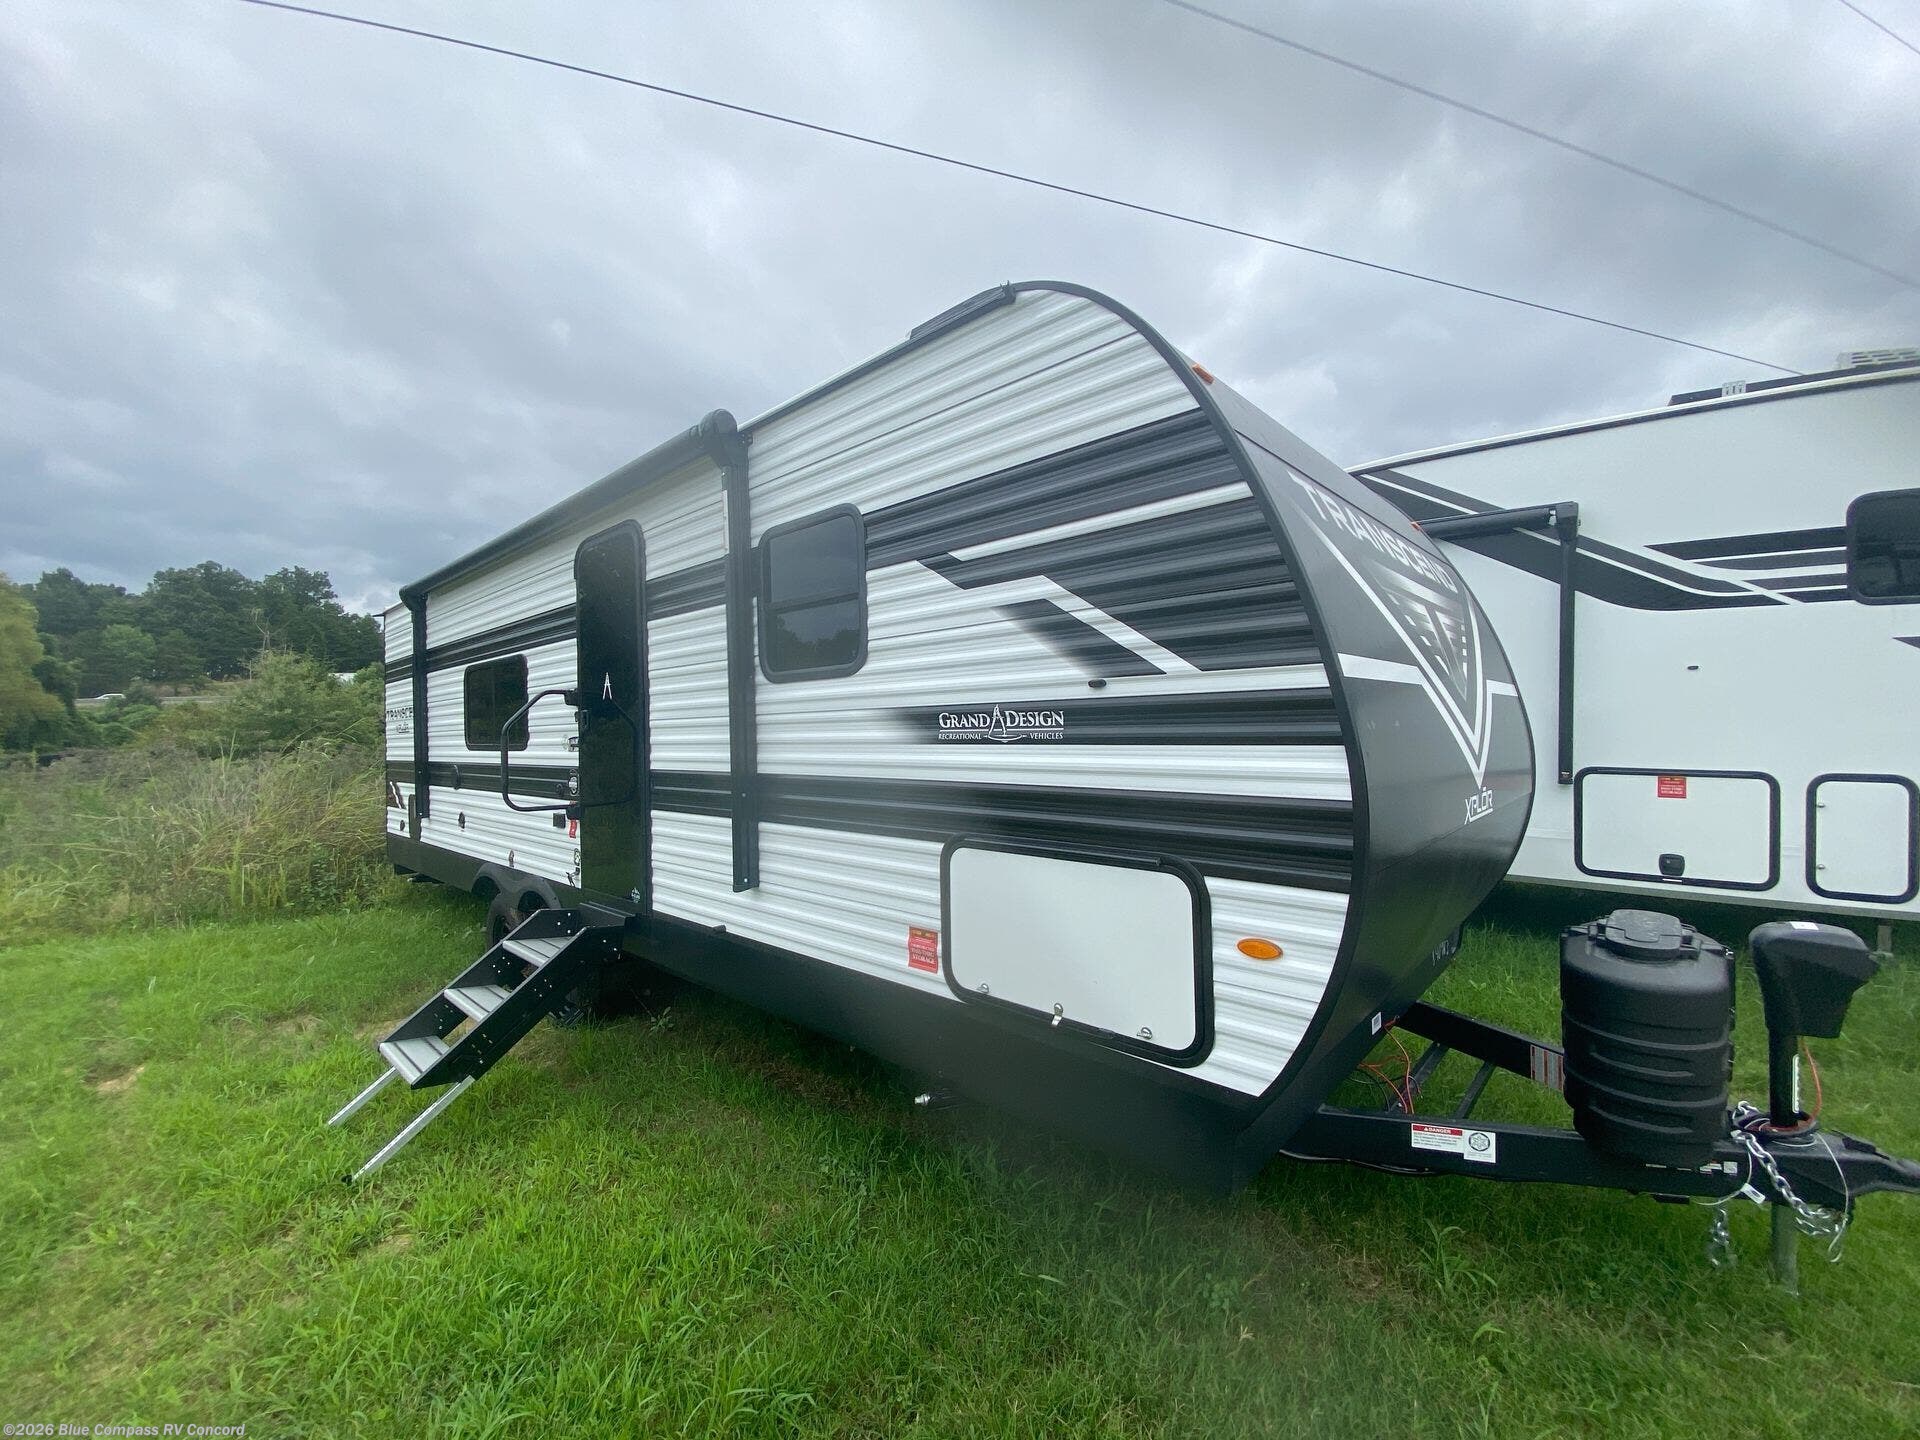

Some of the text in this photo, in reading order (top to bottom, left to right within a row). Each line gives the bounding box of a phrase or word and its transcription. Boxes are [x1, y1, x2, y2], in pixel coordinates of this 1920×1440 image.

[1287, 469, 1458, 594] TRANSCEND
[938, 710, 1064, 729] GRAND DESIGN
[1029, 732, 1064, 740] VEHICLES
[1428, 1127, 1452, 1135] DANGER
